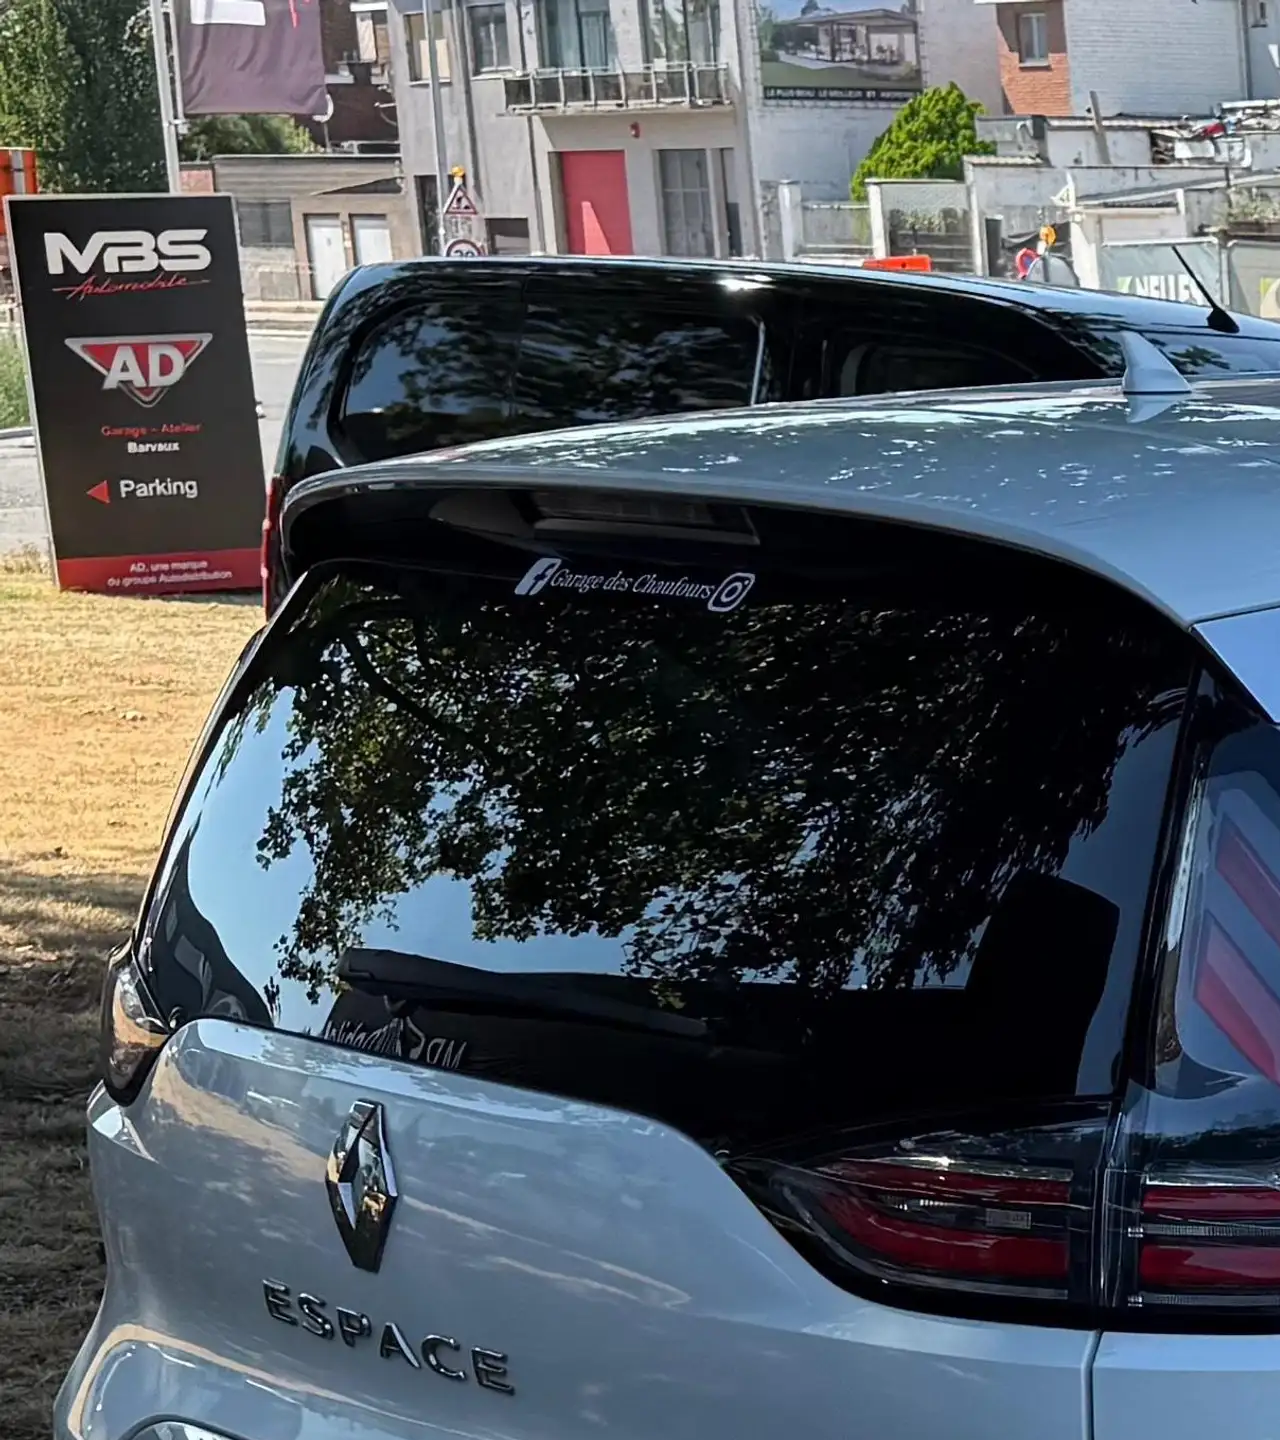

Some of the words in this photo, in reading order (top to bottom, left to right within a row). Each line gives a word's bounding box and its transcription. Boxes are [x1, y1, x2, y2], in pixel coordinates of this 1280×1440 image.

[43, 228, 212, 275] MBS
[101, 343, 186, 390] AD
[101, 425, 148, 438] Garage
[127, 441, 180, 454] Barvaux
[119, 477, 199, 499] Parking
[550, 568, 605, 593] Garage
[603, 571, 635, 591] des
[632, 573, 717, 599] Chaufours
[262, 1277, 515, 1396] ESPACE
